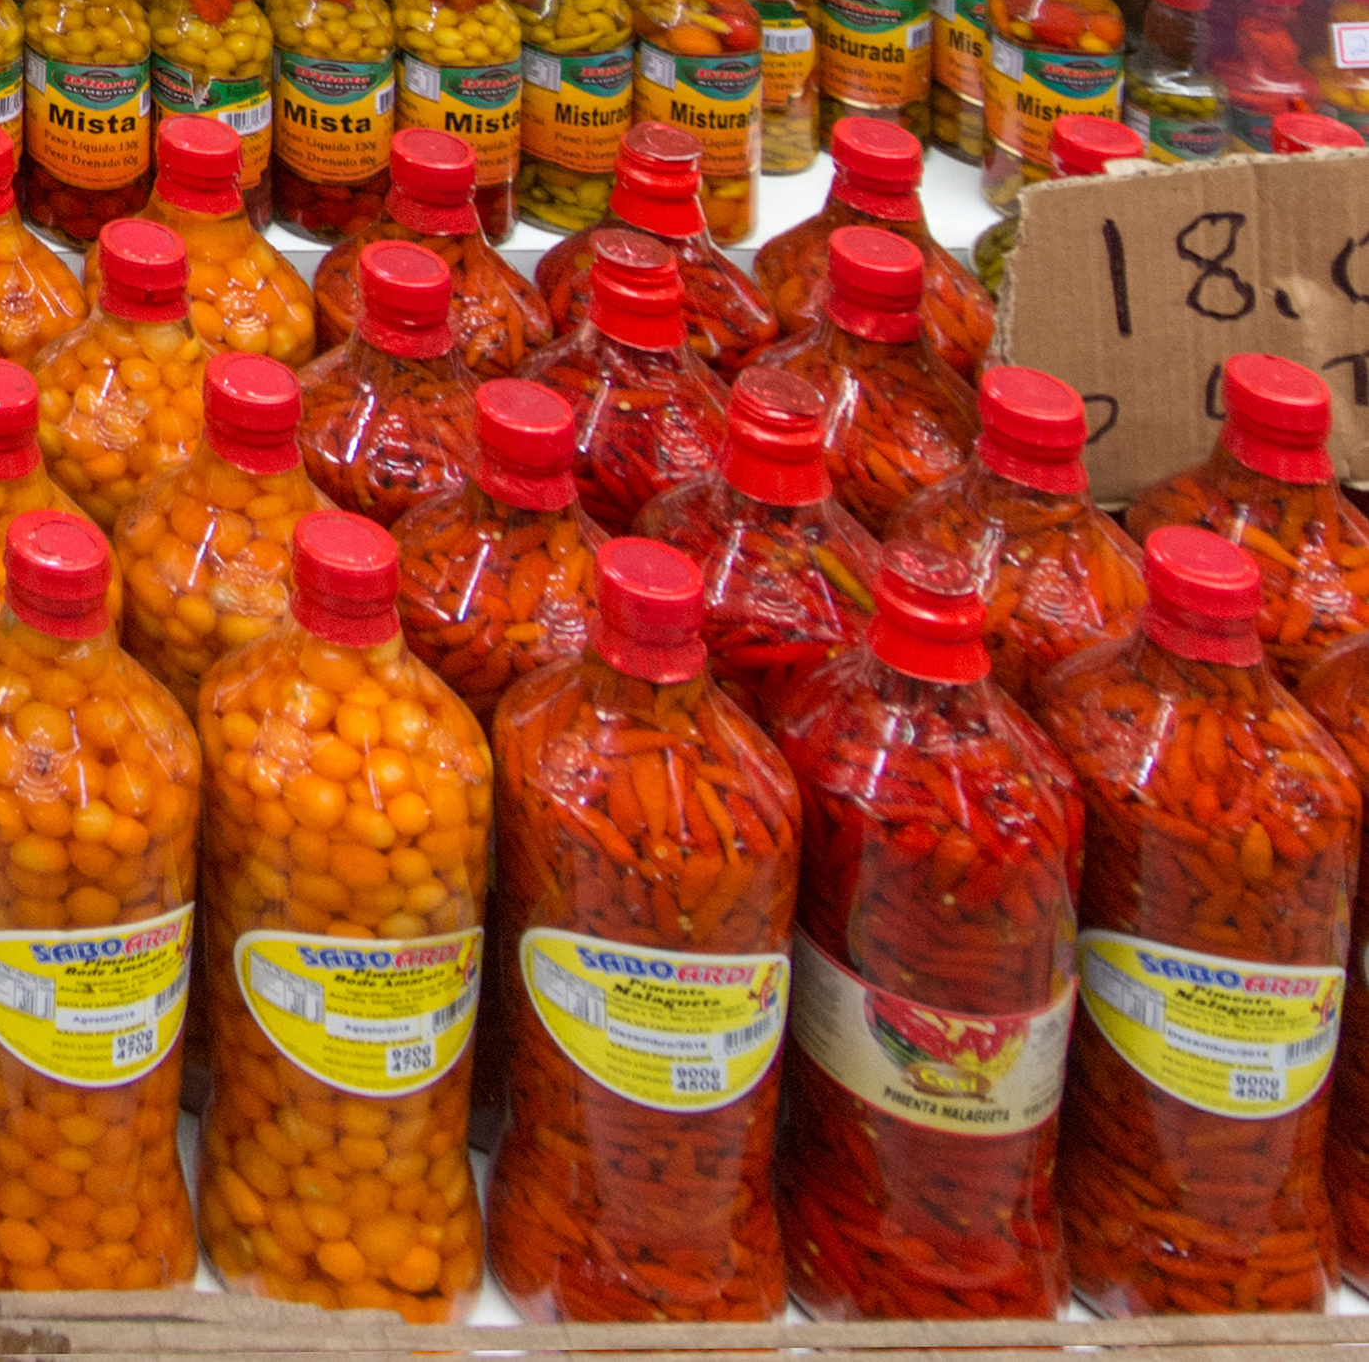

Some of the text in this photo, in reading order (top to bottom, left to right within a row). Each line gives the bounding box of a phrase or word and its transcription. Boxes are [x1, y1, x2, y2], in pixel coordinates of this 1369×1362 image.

[48, 101, 137, 134] Mista
[283, 98, 373, 134] Mista
[575, 946, 755, 987] SABOARDI
[1138, 951, 1318, 996] SABOARDI
[117, 1029, 154, 1048] 920g
[117, 1040, 154, 1061] 470g
[393, 1044, 432, 1061] 920g
[392, 1057, 431, 1073] 470g
[919, 1067, 979, 1091] Casi
[884, 1086, 1010, 1124] PIMENTA MALAGUETA
